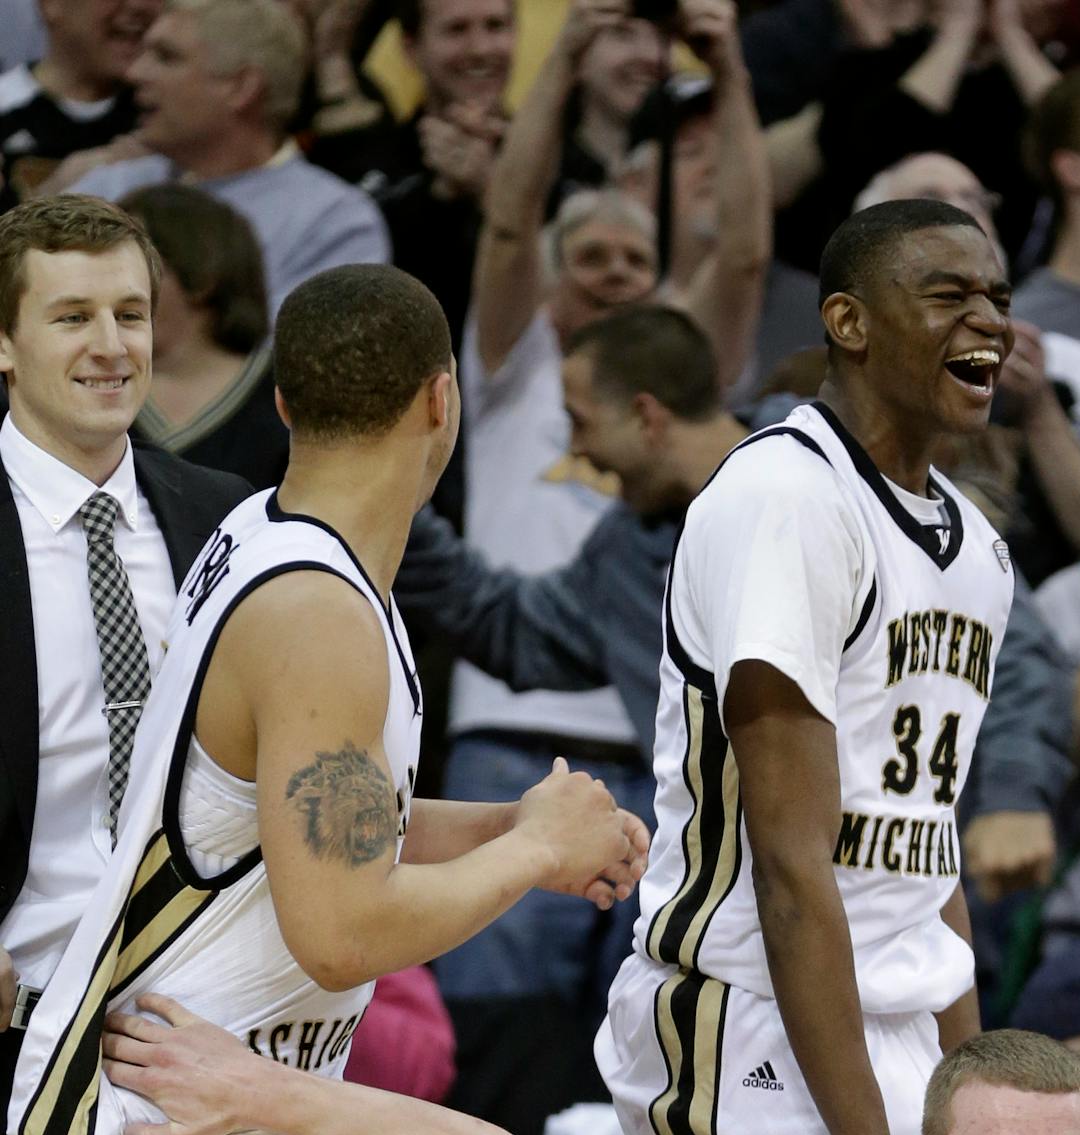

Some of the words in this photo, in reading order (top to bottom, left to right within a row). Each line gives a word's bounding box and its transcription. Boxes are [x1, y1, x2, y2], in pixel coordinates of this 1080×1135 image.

[886, 608, 993, 703] WESTERN
[879, 703, 962, 805] 34
[832, 810, 958, 879] MICHIAN
[742, 1078, 785, 1091] adidas
